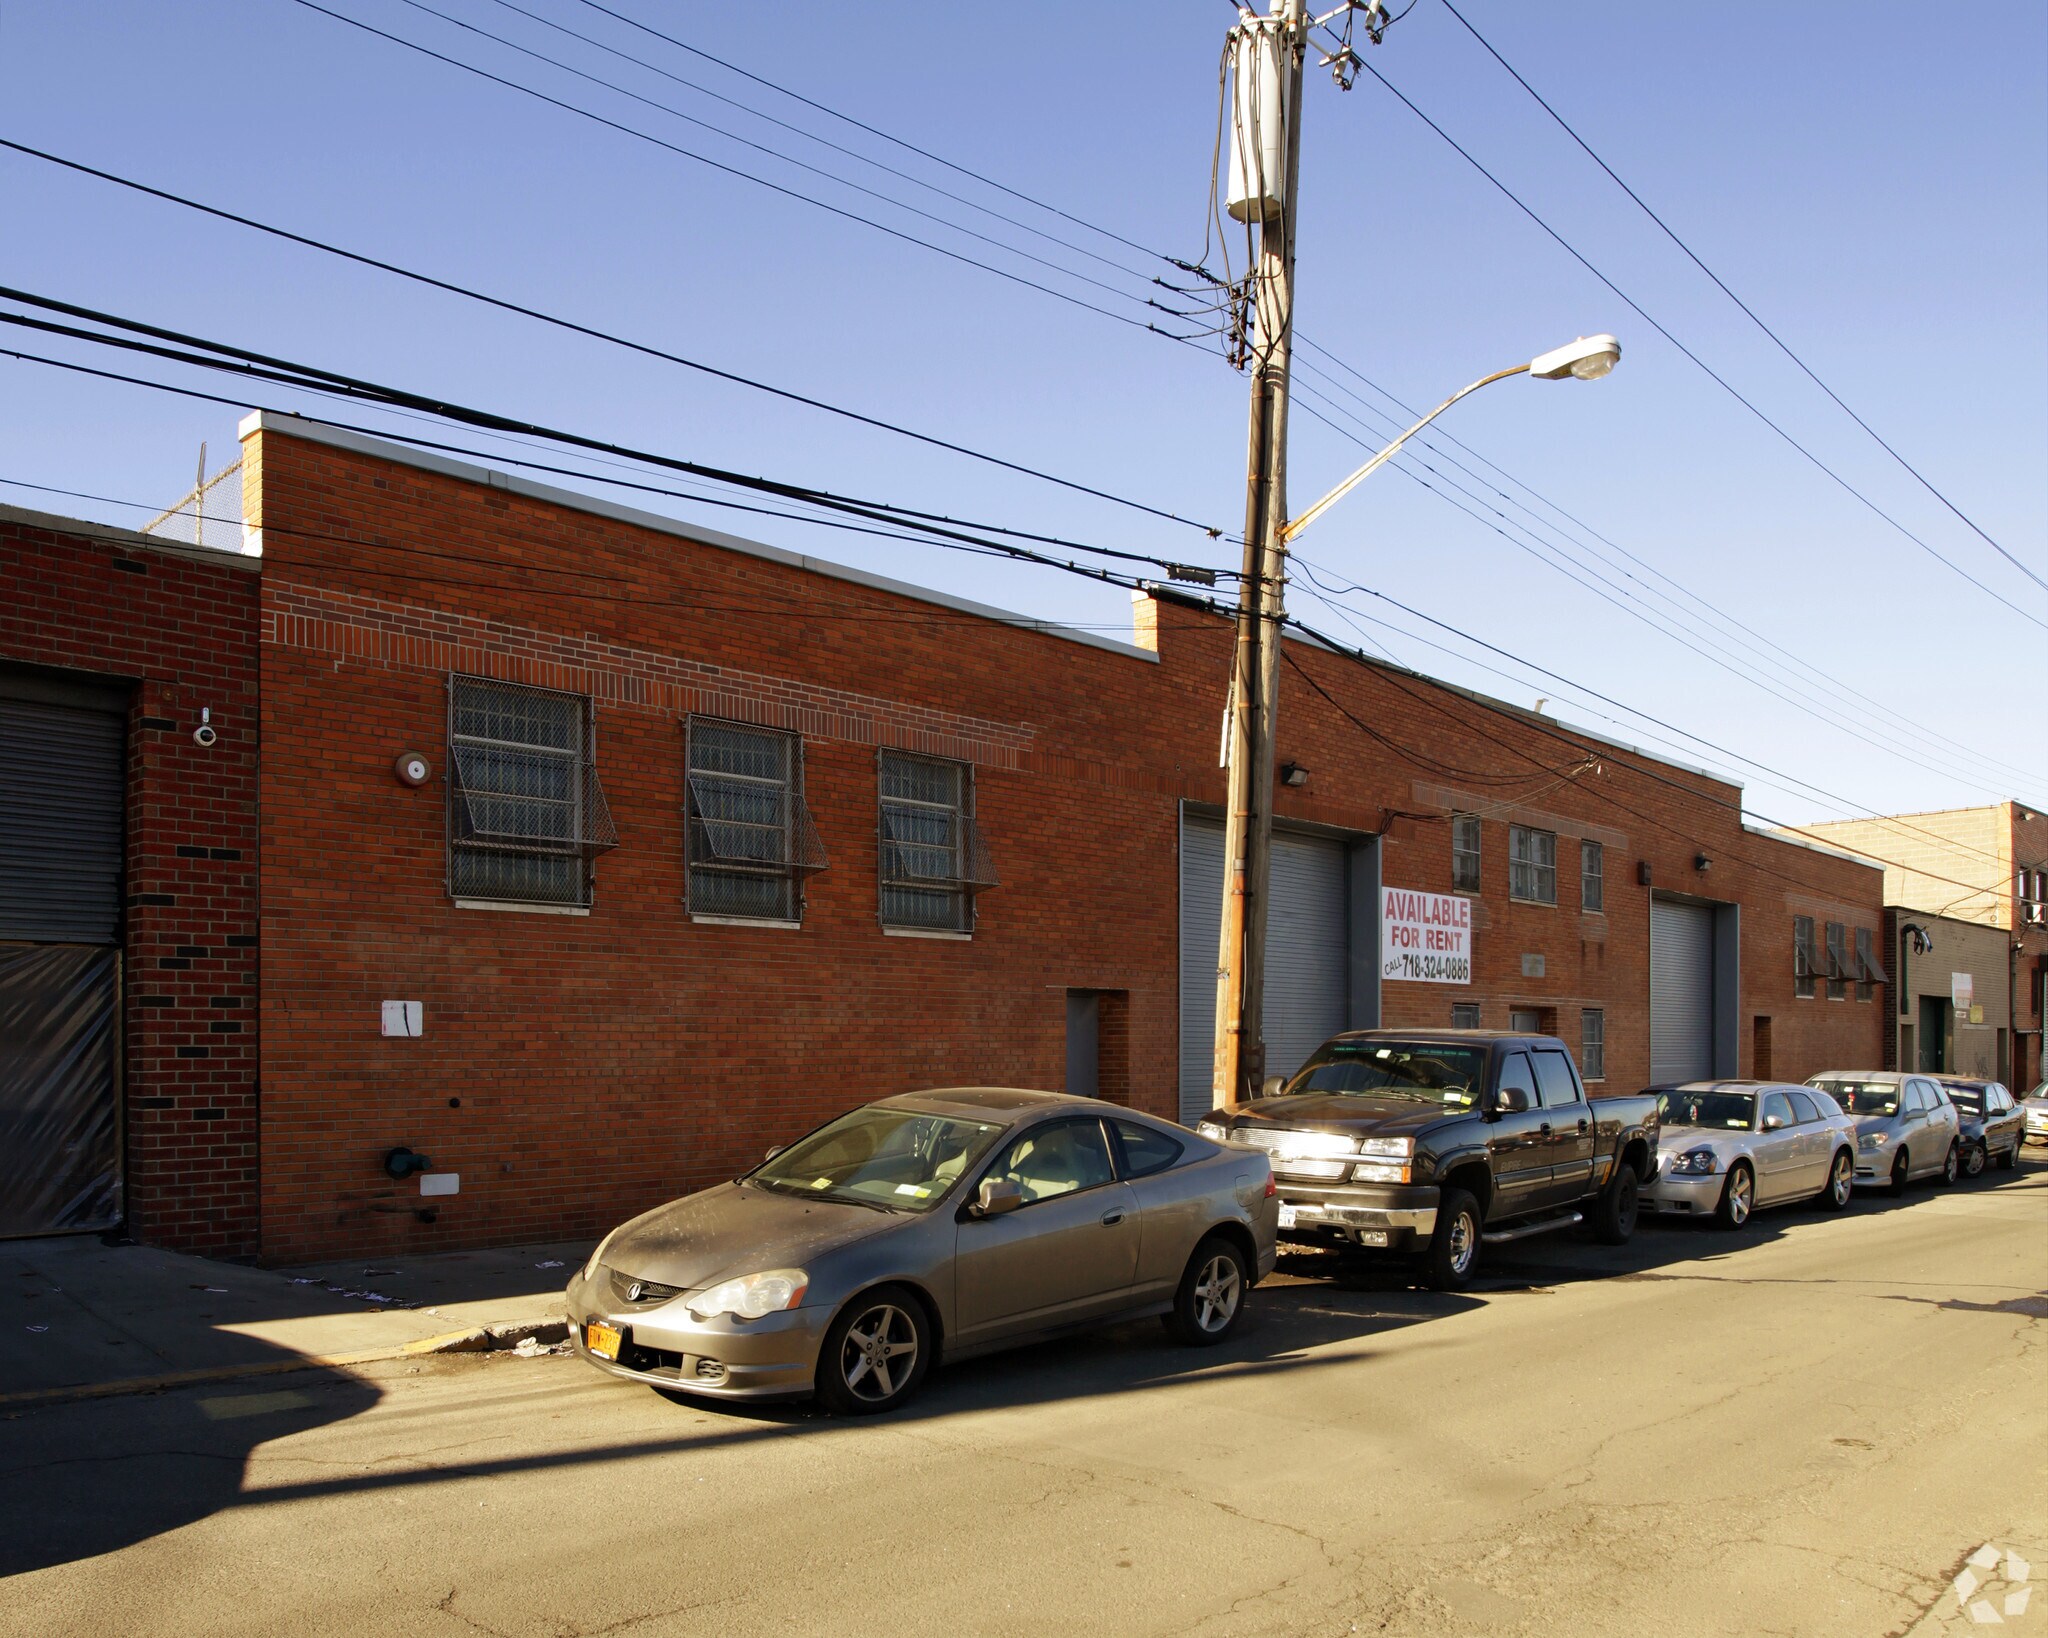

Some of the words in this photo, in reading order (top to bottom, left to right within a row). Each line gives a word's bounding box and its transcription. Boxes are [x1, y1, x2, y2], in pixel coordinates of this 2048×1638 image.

[1385, 891, 1468, 928] AVAILABLE
[1392, 925, 1420, 948] FOR
[1426, 929, 1462, 952] RENT
[1384, 956, 1402, 975] CALL
[1402, 954, 1468, 980] 718-324-0886
